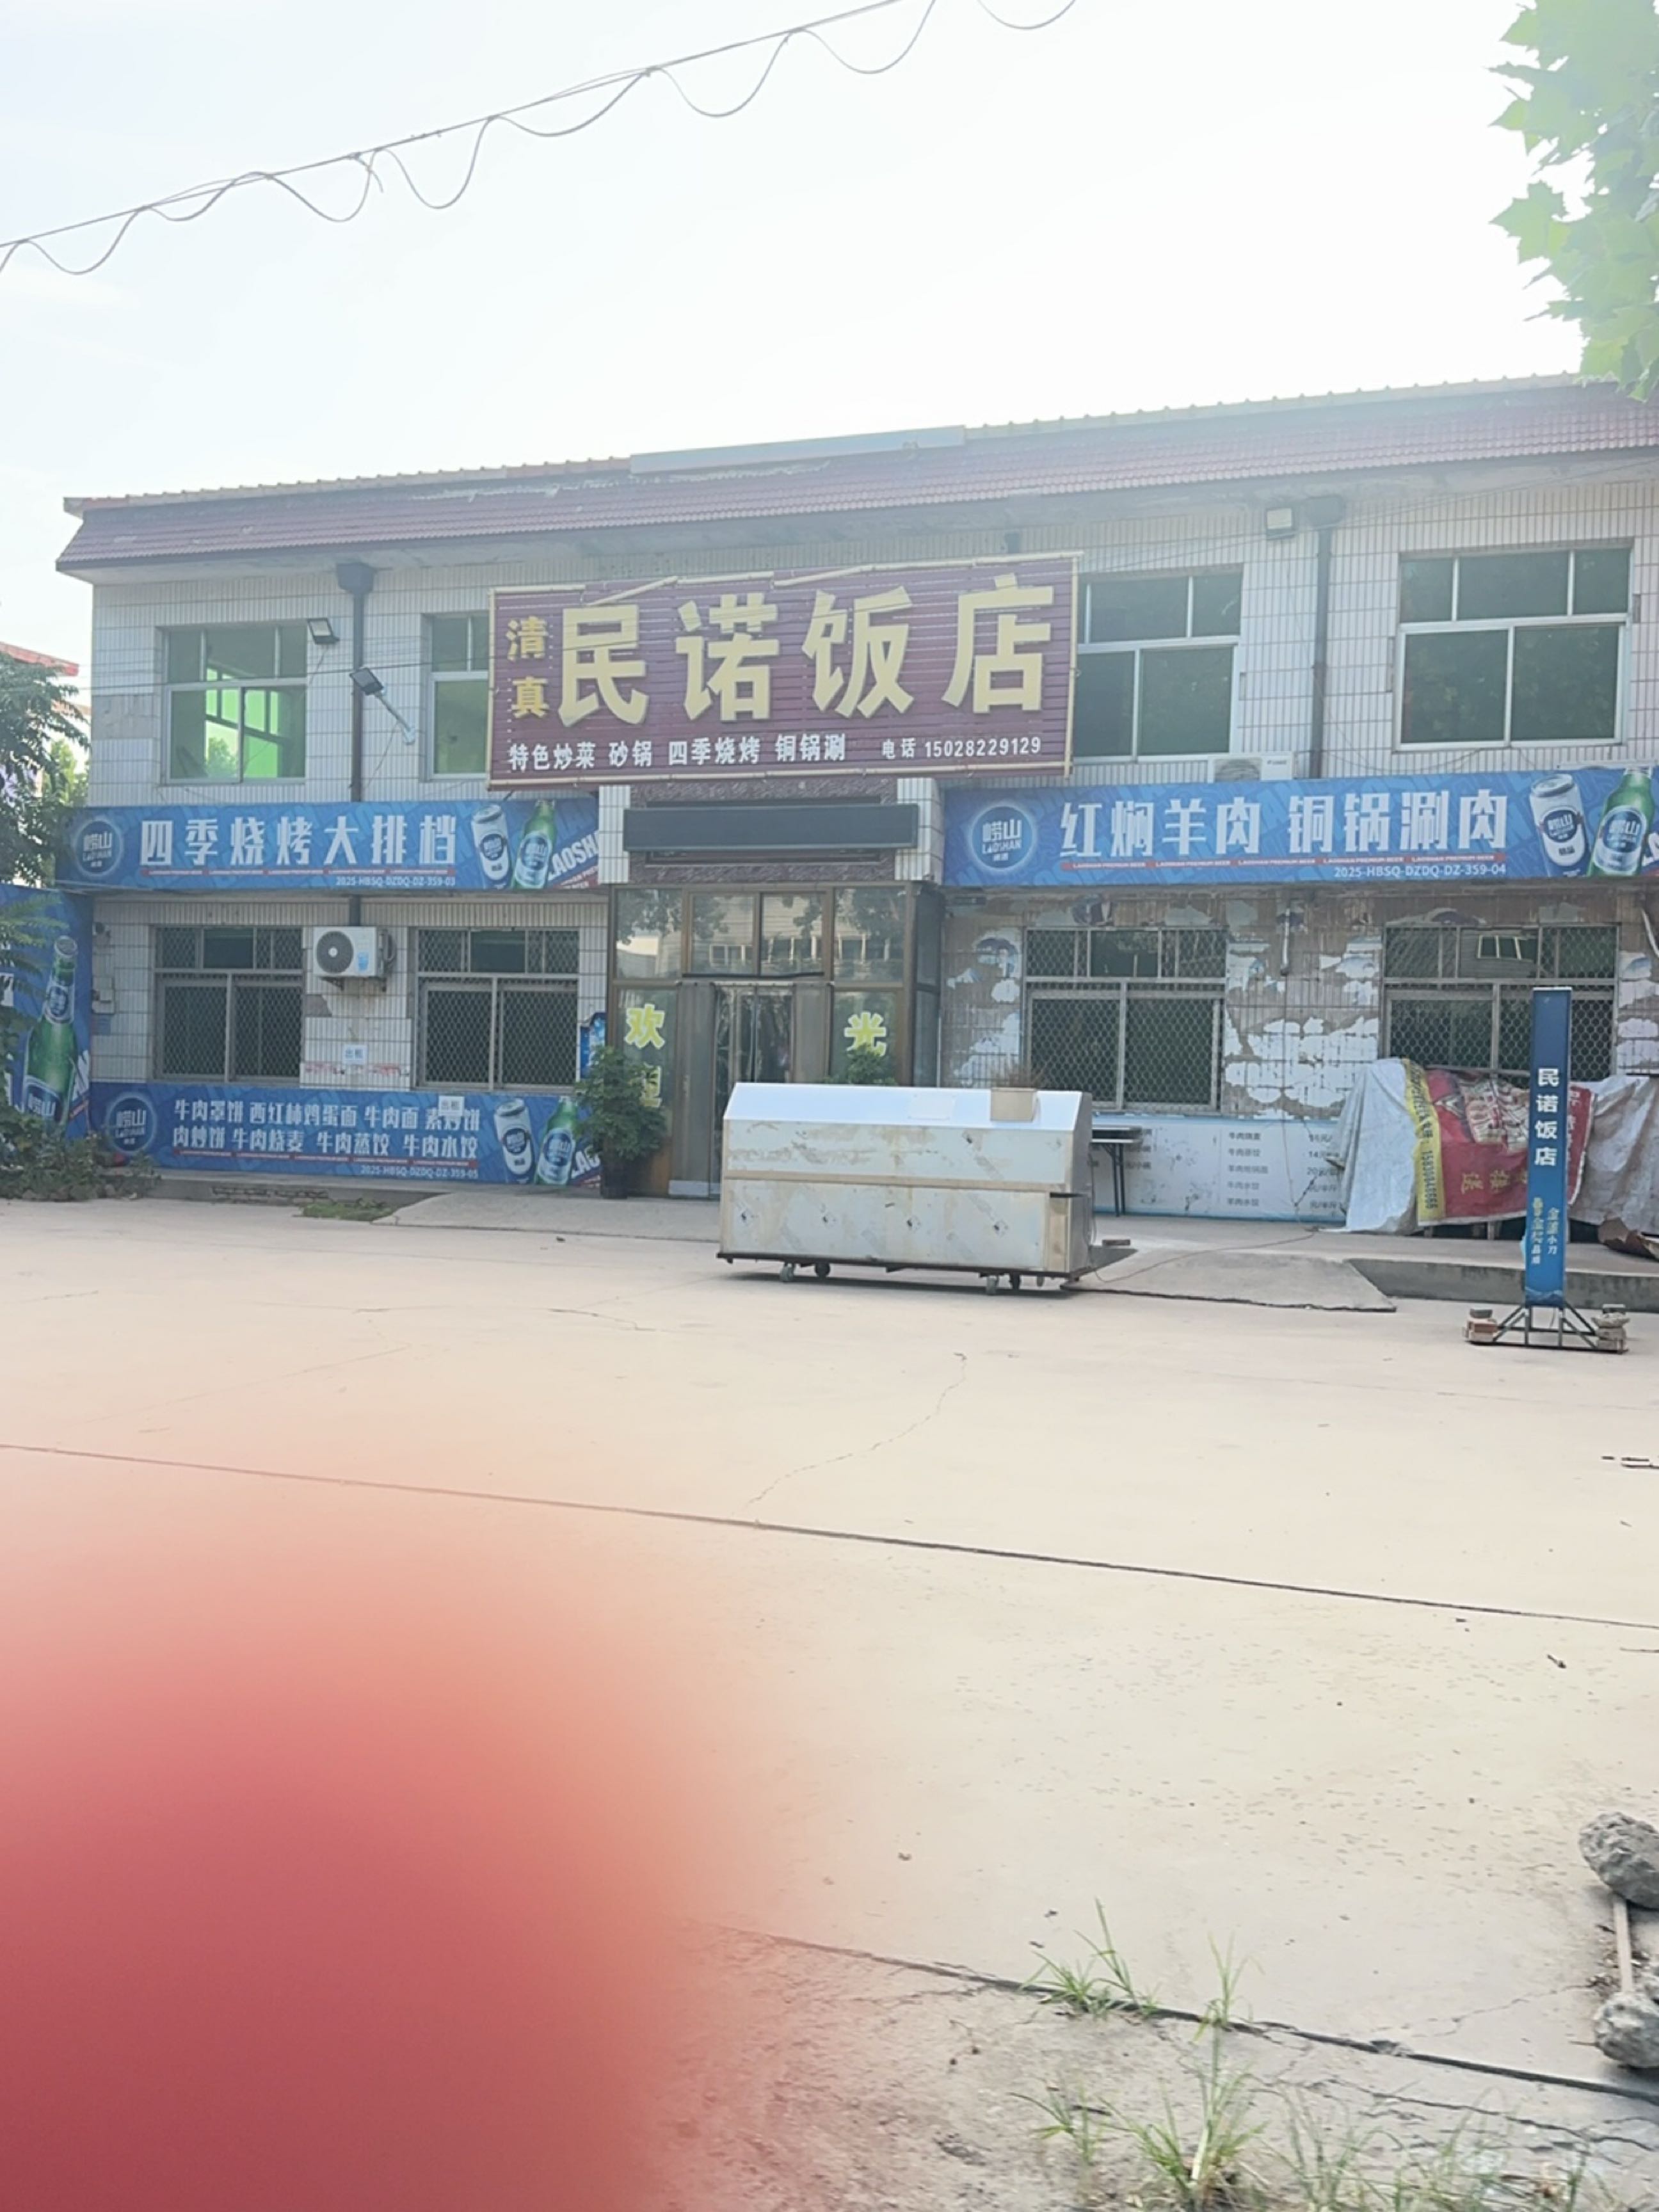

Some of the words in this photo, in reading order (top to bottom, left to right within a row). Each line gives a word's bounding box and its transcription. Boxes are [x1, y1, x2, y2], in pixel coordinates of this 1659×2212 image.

[506, 616, 550, 719] 清真
[557, 573, 1055, 728] 民诺饭店
[508, 741, 597, 772] 特色炒菜
[609, 739, 653, 768] 砂锅
[668, 736, 760, 765] 四季烧烤
[881, 737, 916, 759] 电话
[925, 737, 1042, 758] 15028229129
[140, 815, 456, 866] 四季烧烤大排档
[1060, 796, 1262, 858] 红焖羊肉
[1288, 788, 1508, 854] 铜锅涮肉
[844, 1011, 886, 1057] 光
[250, 1101, 358, 1128] 西红柿鸡蛋面
[364, 1105, 419, 1130] 牛肉面
[1534, 1067, 1559, 1167] 民诺饭店
[316, 1130, 390, 1157] 牛肉蒸饺
[403, 1133, 478, 1158] 牛肉水饺
